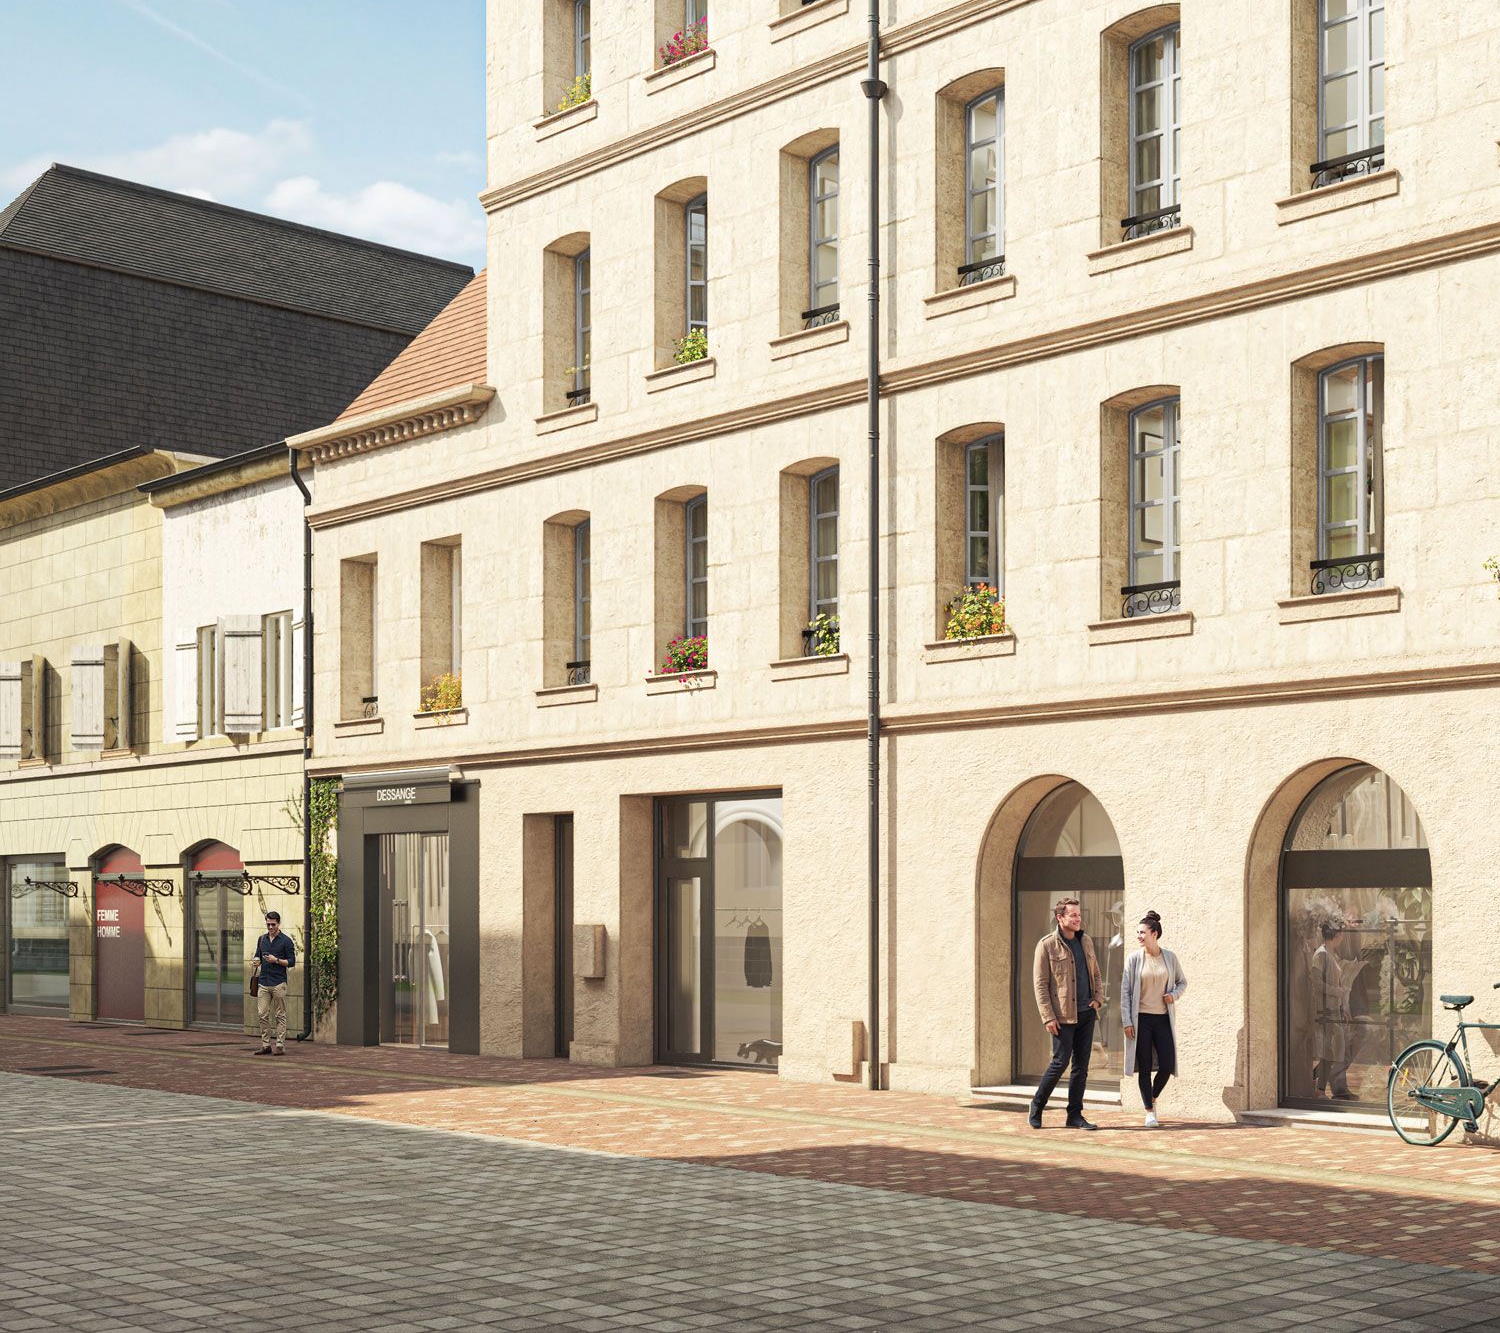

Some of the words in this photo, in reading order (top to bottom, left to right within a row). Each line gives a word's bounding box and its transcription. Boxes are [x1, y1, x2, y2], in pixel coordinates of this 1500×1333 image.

[376, 787, 416, 802] DESSANGE
[97, 909, 119, 921] FEMME
[97, 926, 120, 937] HOMME
